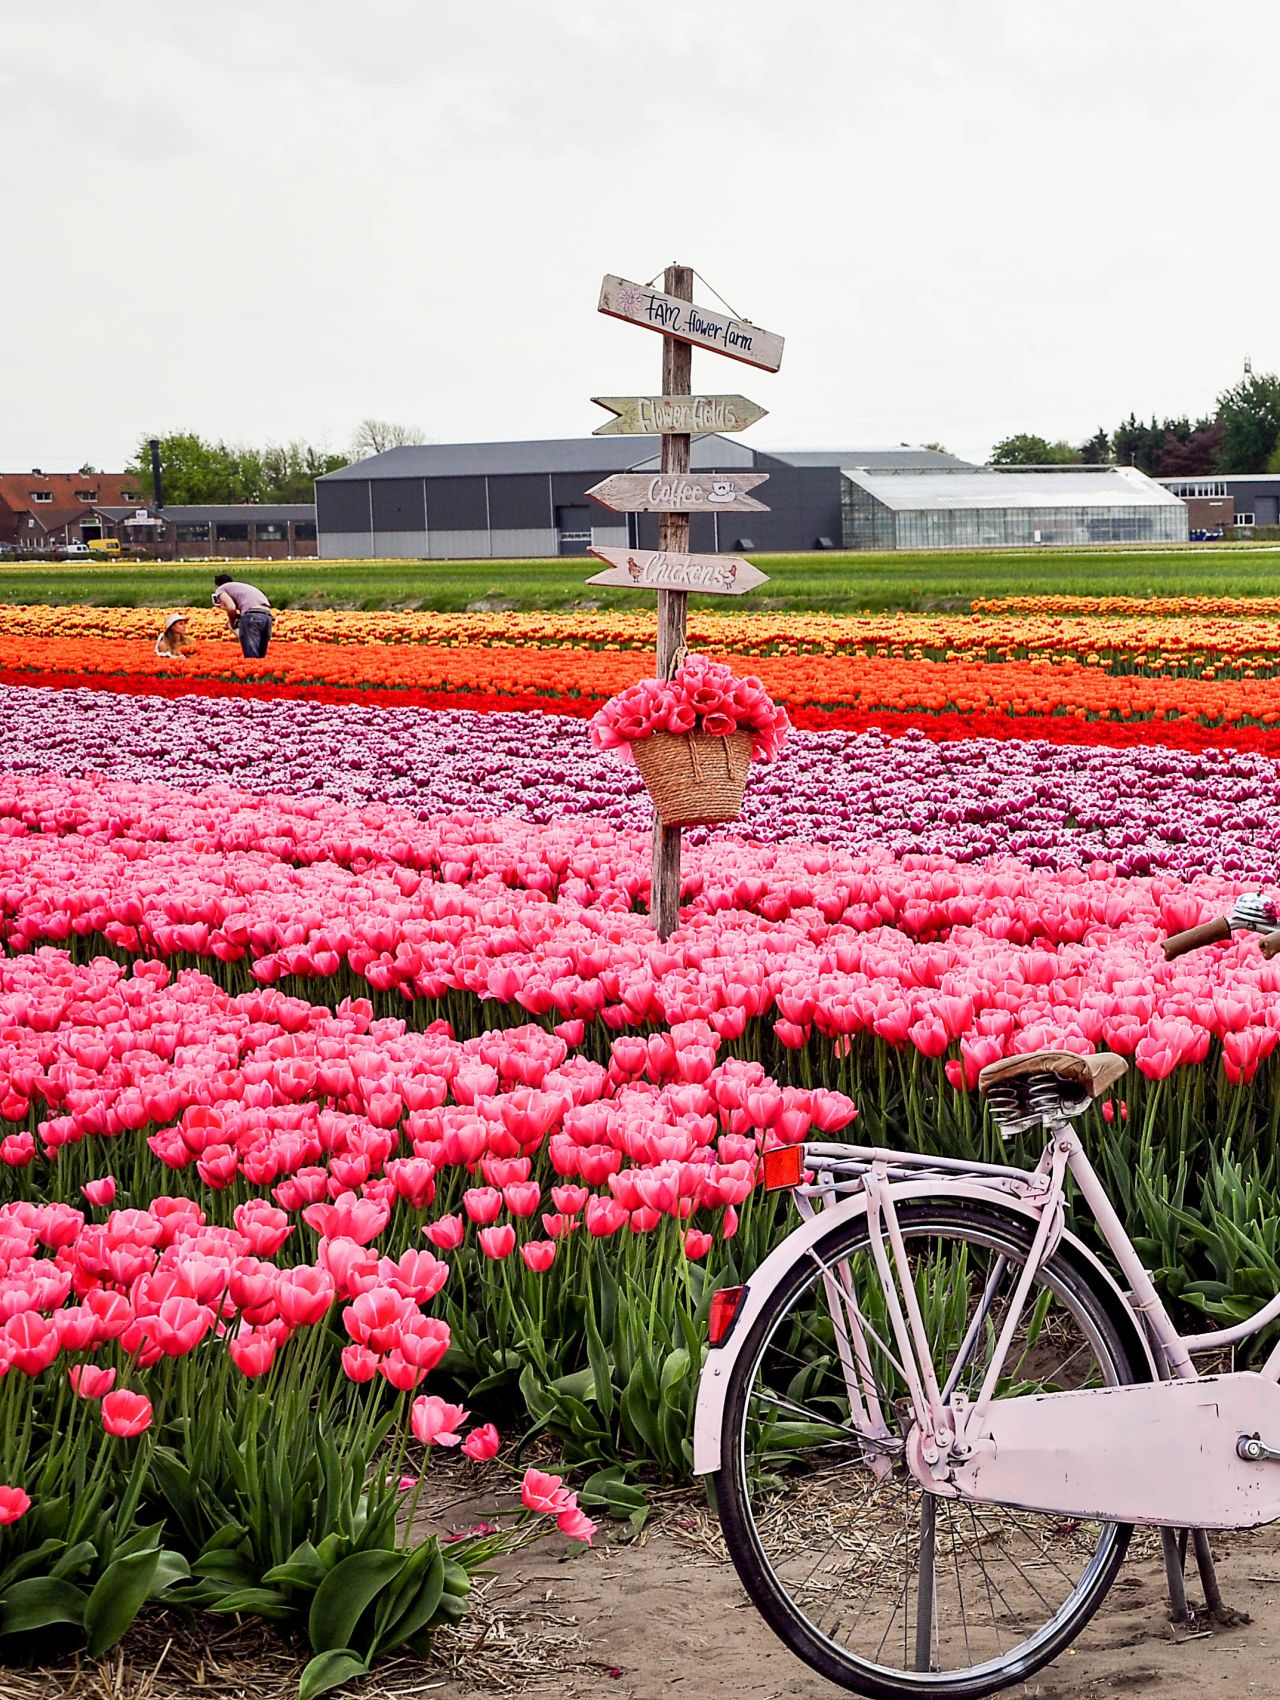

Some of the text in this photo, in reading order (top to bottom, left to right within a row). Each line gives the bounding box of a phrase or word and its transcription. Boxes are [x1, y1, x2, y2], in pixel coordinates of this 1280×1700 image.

[684, 310, 722, 340] flower
[721, 321, 753, 351] farm
[647, 477, 704, 508] Coffee
[644, 553, 726, 586] Chickens
